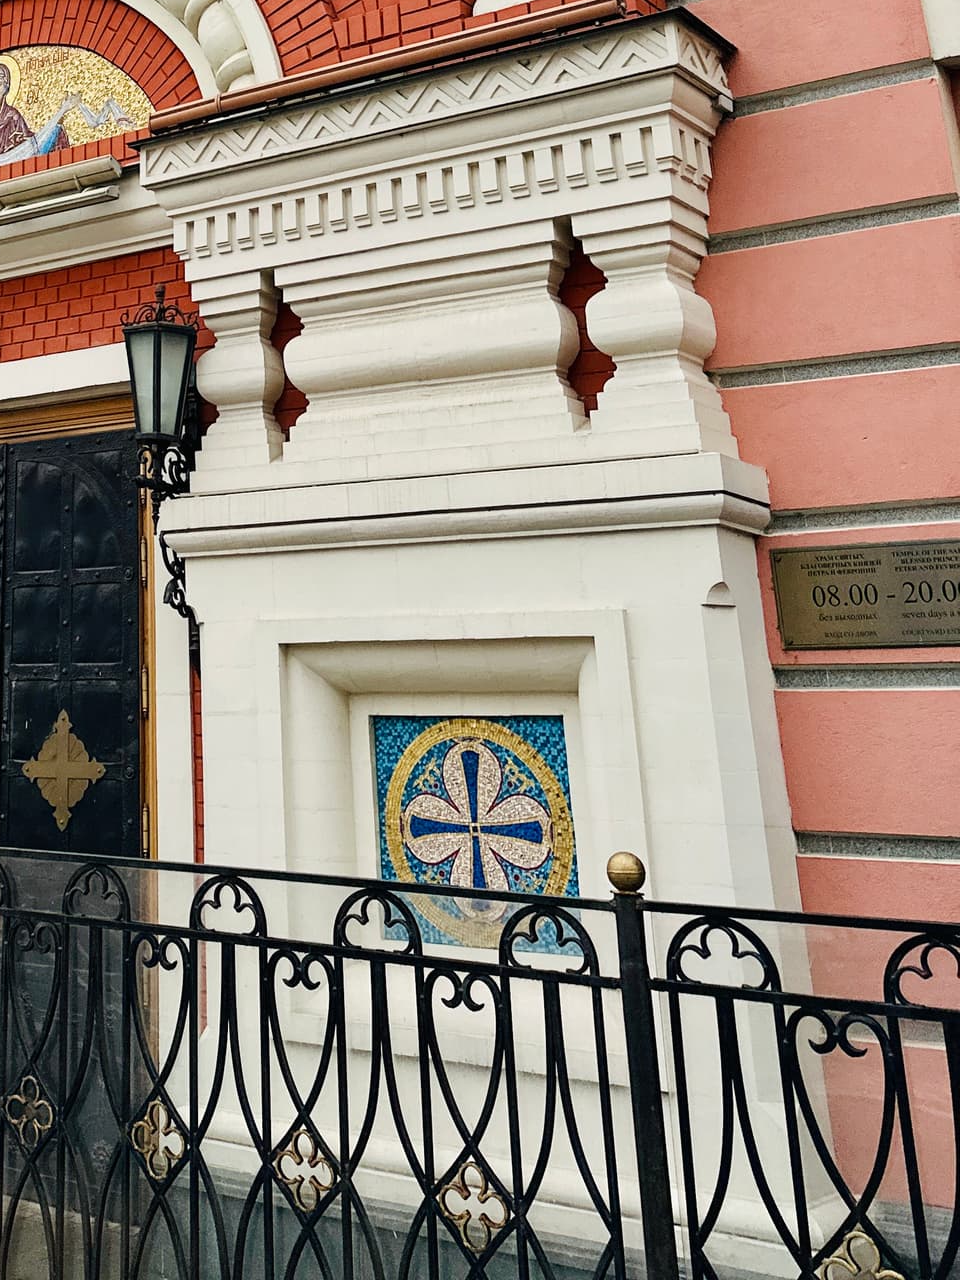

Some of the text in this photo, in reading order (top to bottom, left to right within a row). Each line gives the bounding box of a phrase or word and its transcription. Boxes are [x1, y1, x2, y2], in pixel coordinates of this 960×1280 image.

[812, 582, 879, 608] 08.00
[818, 613, 833, 622] без
[927, 609, 947, 620] days
